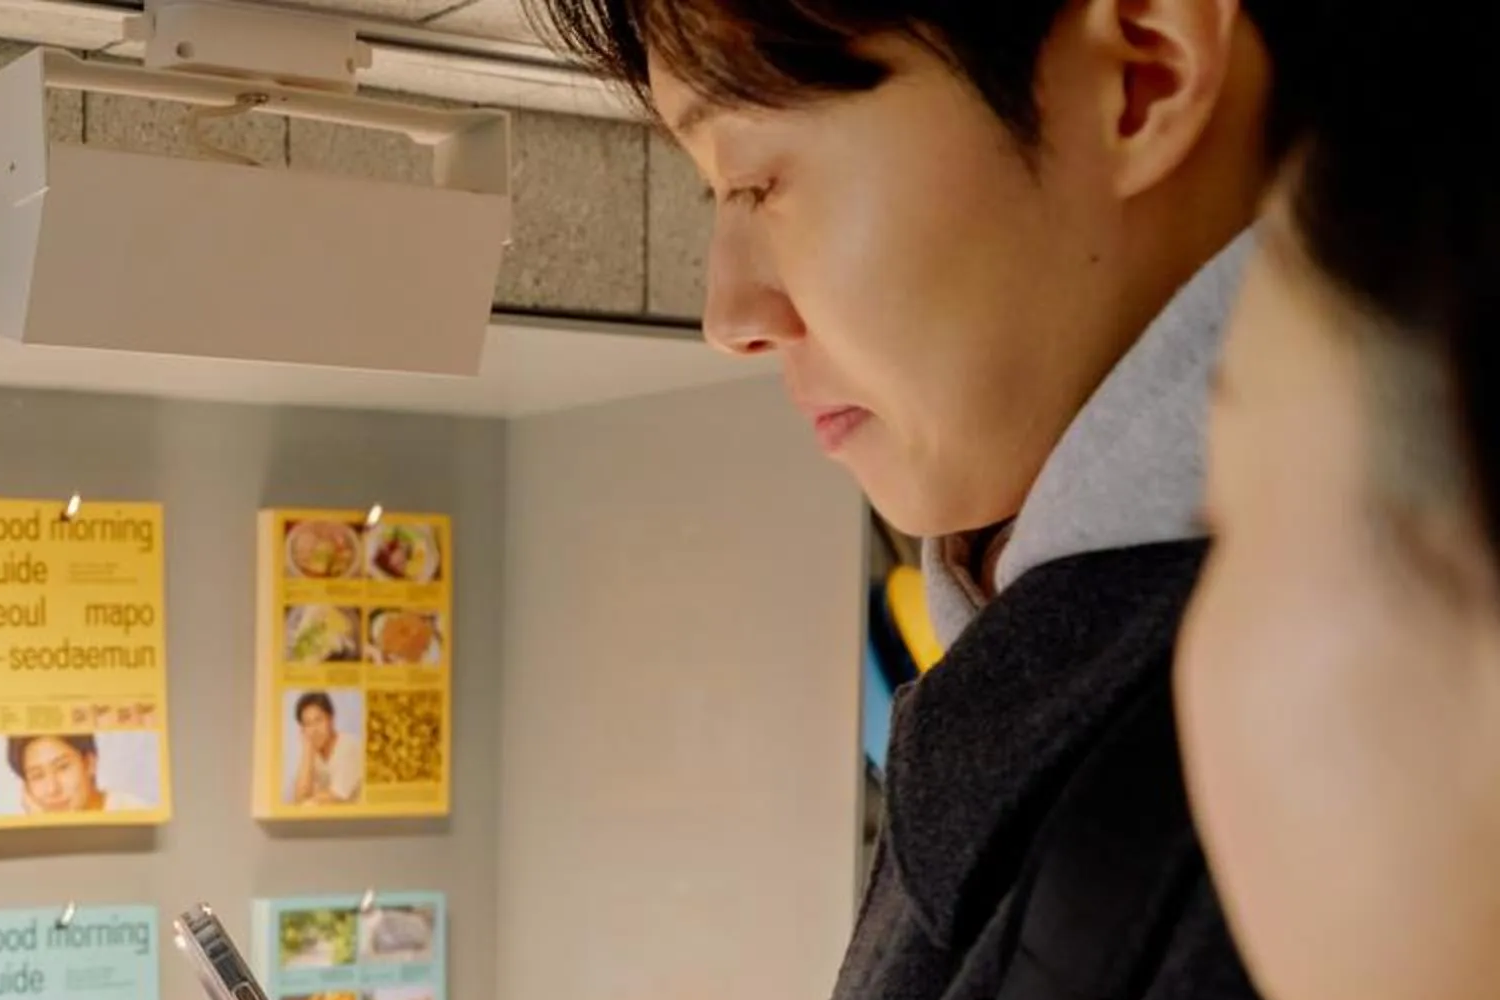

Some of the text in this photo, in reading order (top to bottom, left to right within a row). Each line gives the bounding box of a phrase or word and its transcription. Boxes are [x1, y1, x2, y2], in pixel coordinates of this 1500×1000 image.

[50, 509, 154, 553] morning
[84, 602, 155, 636] mapo
[46, 914, 149, 956] morning
